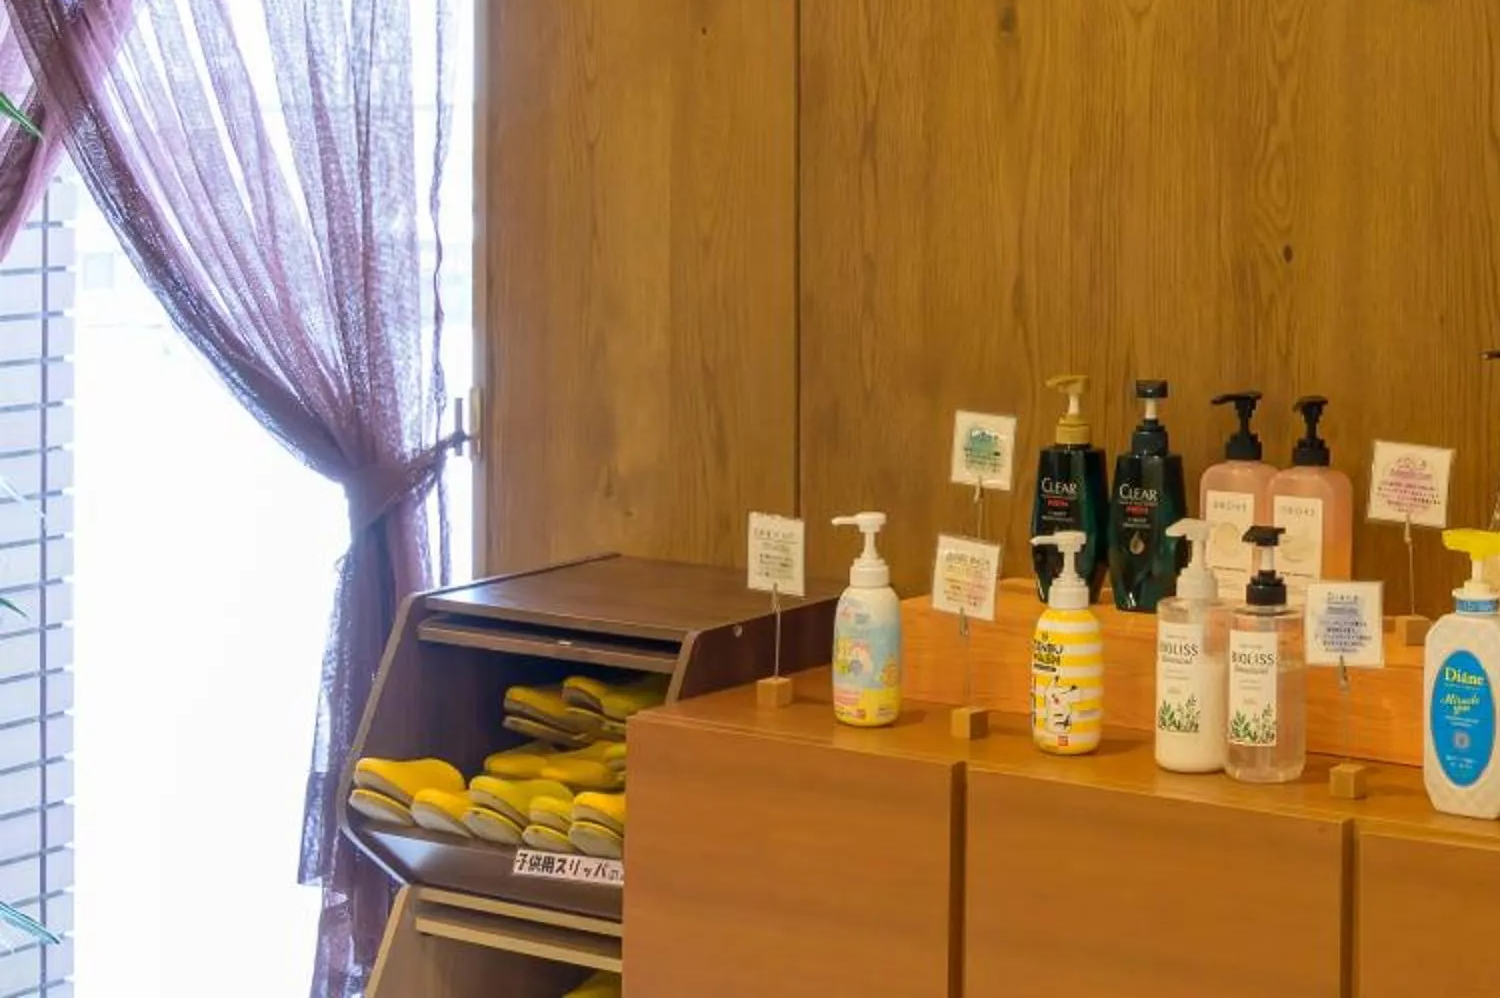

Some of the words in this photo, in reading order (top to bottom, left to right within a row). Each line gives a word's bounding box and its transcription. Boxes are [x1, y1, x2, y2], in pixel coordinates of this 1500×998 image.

[1041, 477, 1077, 495] CLEAR
[1120, 483, 1158, 501] CLEAR
[1445, 666, 1485, 685] Diane
